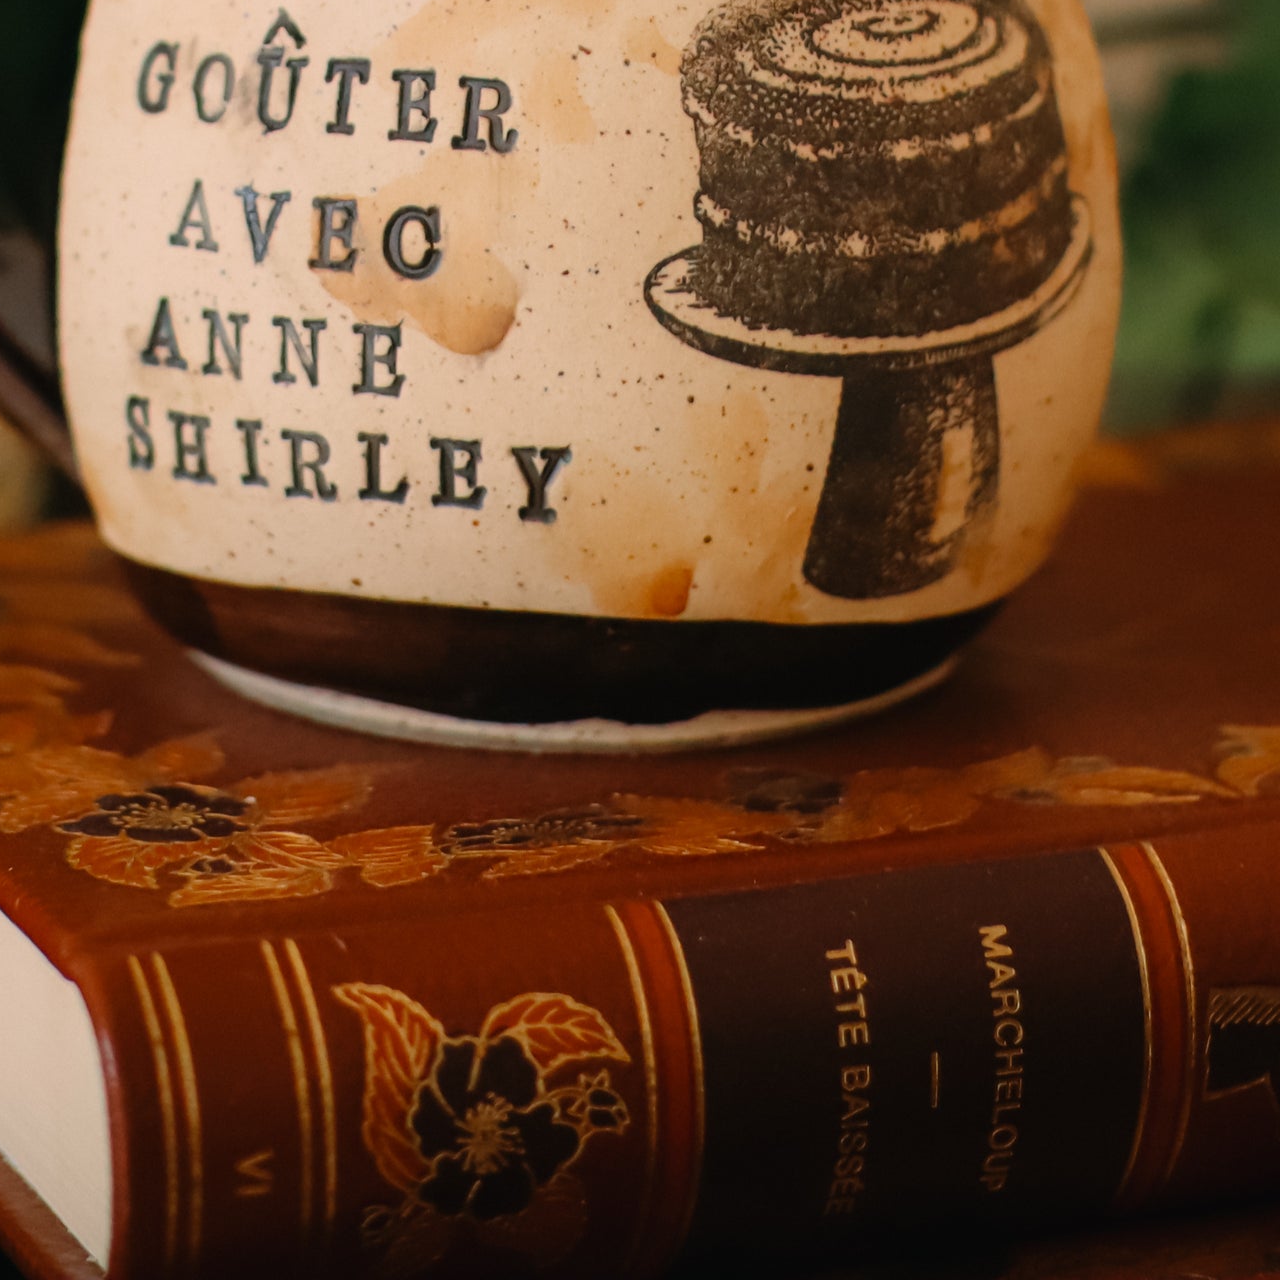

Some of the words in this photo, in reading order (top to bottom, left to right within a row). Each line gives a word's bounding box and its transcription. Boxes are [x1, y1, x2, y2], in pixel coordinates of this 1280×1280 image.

[135, 7, 520, 155] GOÛTER
[168, 178, 444, 281] AVEC
[140, 296, 407, 398] ANNE
[125, 393, 573, 524] SHIRLEY
[824, 938, 870, 1049] TÊTE
[978, 923, 1024, 1193] MARCHELOUP
